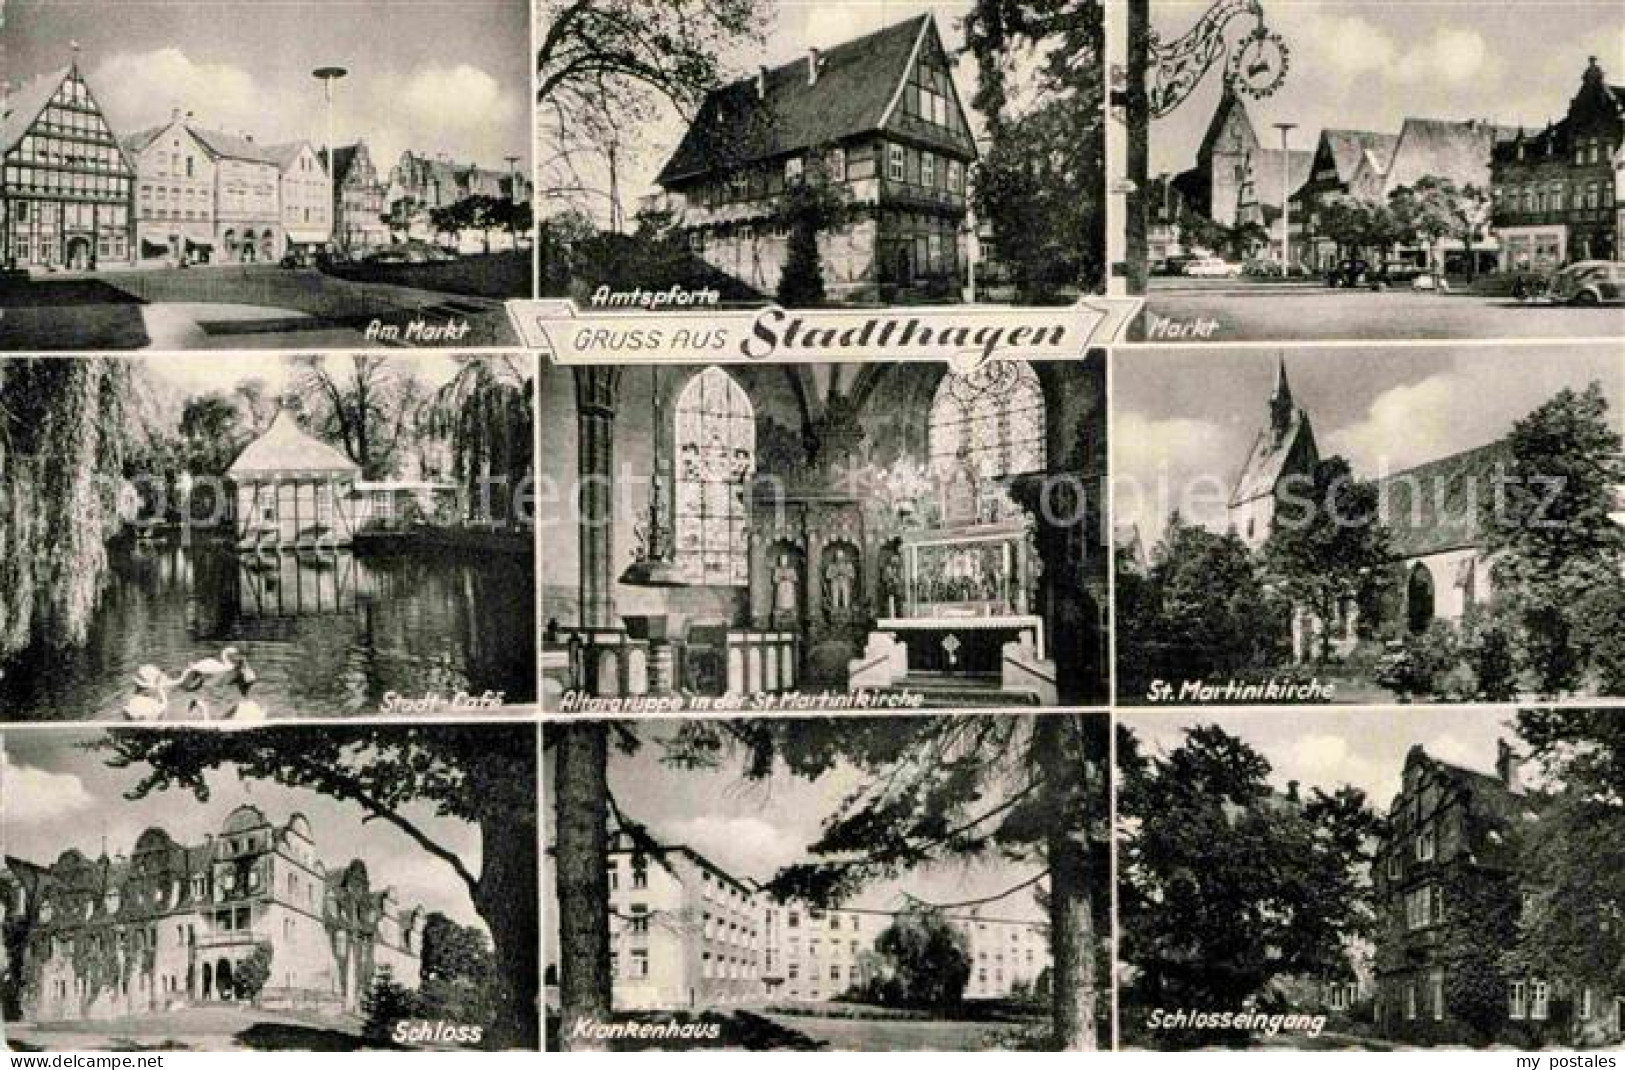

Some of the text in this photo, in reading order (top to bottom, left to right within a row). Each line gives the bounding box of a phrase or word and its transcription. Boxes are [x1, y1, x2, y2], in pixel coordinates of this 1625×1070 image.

[592, 286, 719, 309] Amtspforte
[364, 317, 471, 340] Am Markt
[574, 306, 1066, 367] GRUSS AUS Stadthagen
[1148, 316, 1220, 339] Markt
[560, 690, 684, 712] Altargruppe
[691, 690, 713, 710] in
[715, 688, 745, 710] der
[392, 1020, 483, 1043] Schloss
[573, 1016, 721, 1039] Krankenhaus
[1147, 1008, 1327, 1038] Schlosseingang
